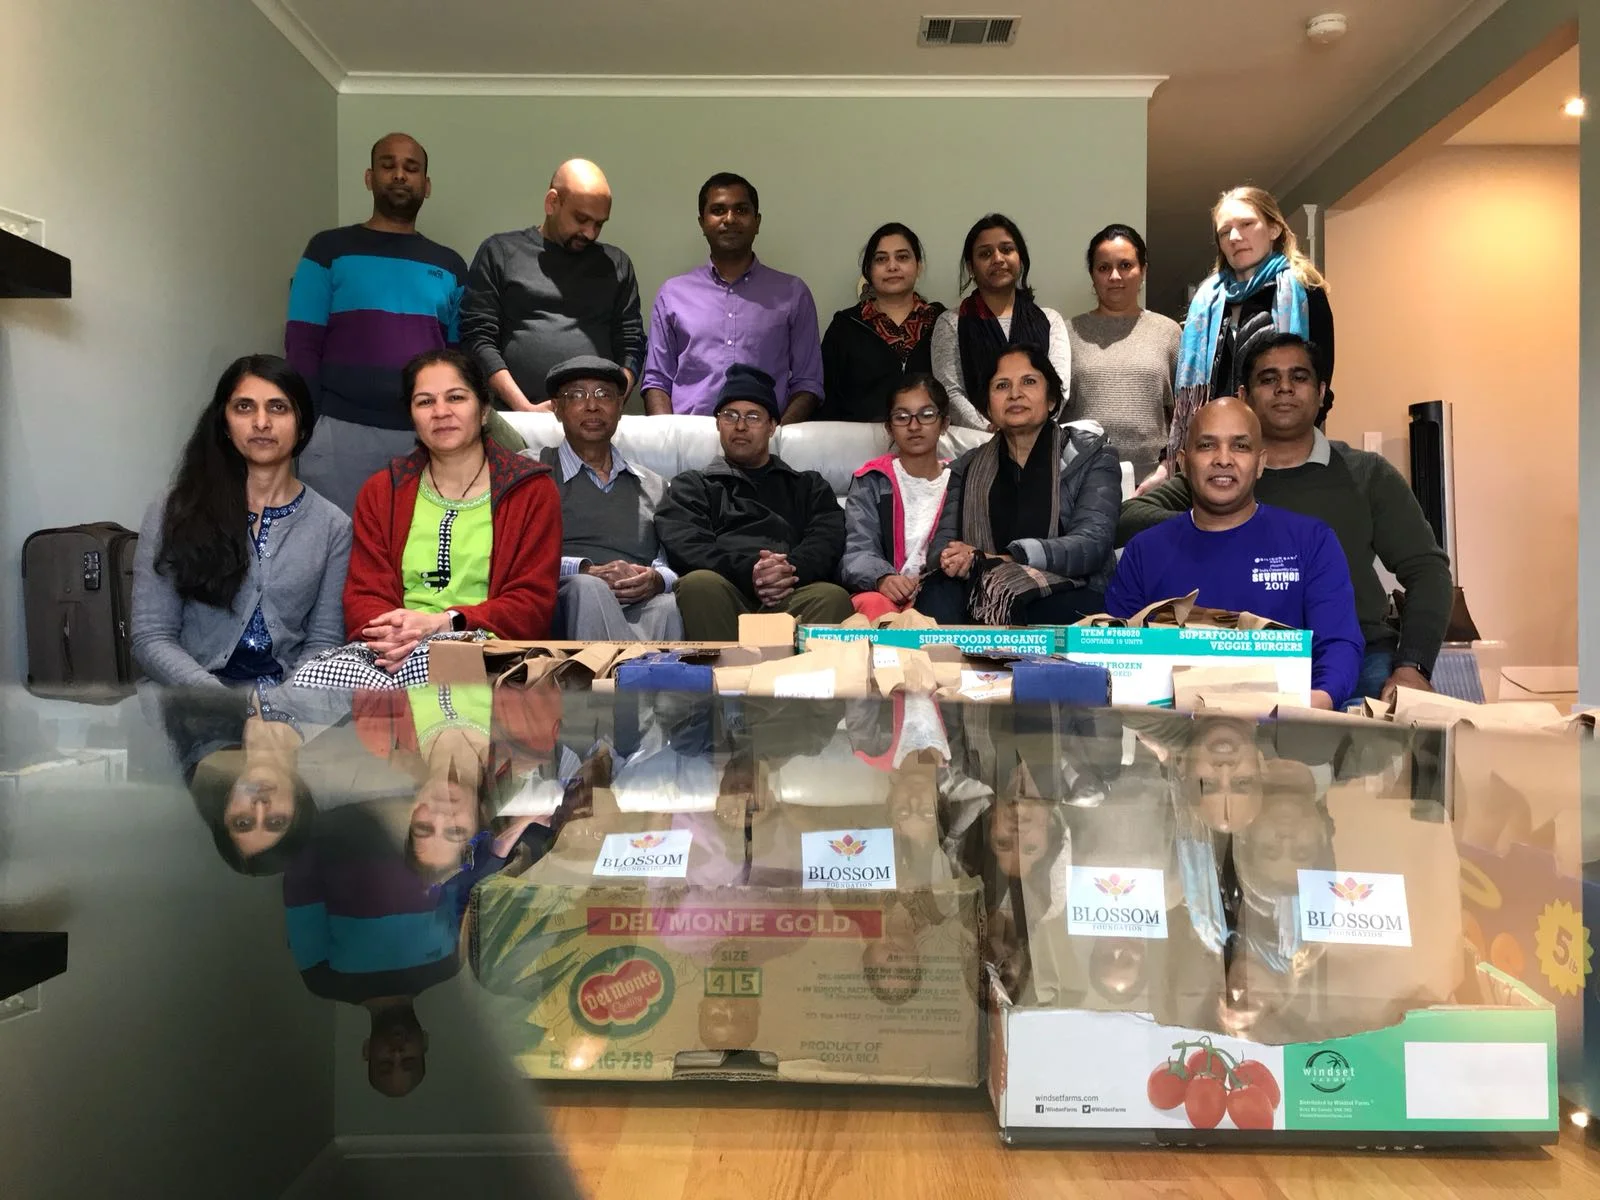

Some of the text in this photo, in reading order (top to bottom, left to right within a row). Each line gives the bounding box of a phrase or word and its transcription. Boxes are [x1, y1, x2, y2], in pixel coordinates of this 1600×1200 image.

[1265, 582, 1290, 590] 2017
[1080, 629, 1105, 637] ITEM
[1180, 630, 1303, 641] SUPERFOODS ORGANIC
[919, 634, 991, 644] SUPERFOODS
[994, 634, 1047, 645] ORGANIC
[1210, 641, 1303, 651] VEGGIE BURGERS
[1106, 662, 1142, 670] FROZEN
[602, 853, 684, 868] BLOSSOM
[808, 865, 890, 881] BLOSSOM
[826, 881, 873, 889] FOUNDATION
[1072, 906, 1160, 924] BLOSSOM
[1306, 910, 1403, 931] BLOSSOM
[609, 912, 851, 933] DEL MONTE GOLD
[1092, 924, 1142, 932] FOUNDATION
[1552, 925, 1573, 966] 5
[721, 951, 749, 962] SIZE
[712, 974, 726, 991] 4
[740, 974, 754, 991] 5
[585, 969, 659, 1011] Del Monte
[799, 1041, 884, 1052] PRODUCT OF
[820, 1052, 880, 1064] COSTA RICA
[1302, 1067, 1355, 1077] windset
[1035, 1094, 1099, 1102] windsetfarms.com
